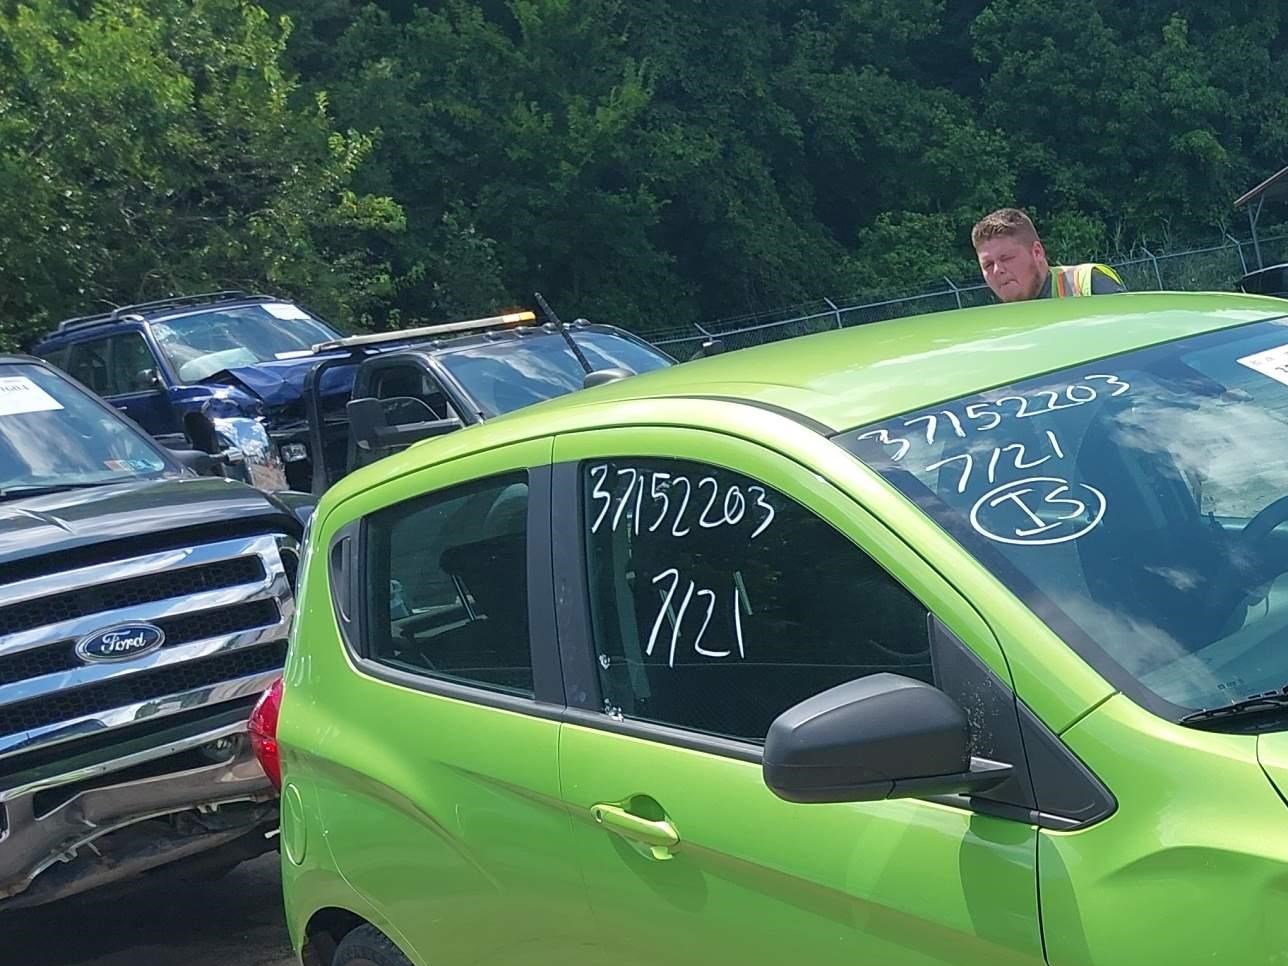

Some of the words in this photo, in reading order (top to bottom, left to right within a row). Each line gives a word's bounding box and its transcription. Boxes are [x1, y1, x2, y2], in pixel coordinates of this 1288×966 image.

[858, 374, 1130, 462] 37152203
[590, 463, 775, 539] 37152203
[100, 630, 147, 654] Ford
[645, 568, 745, 668] 7/21
